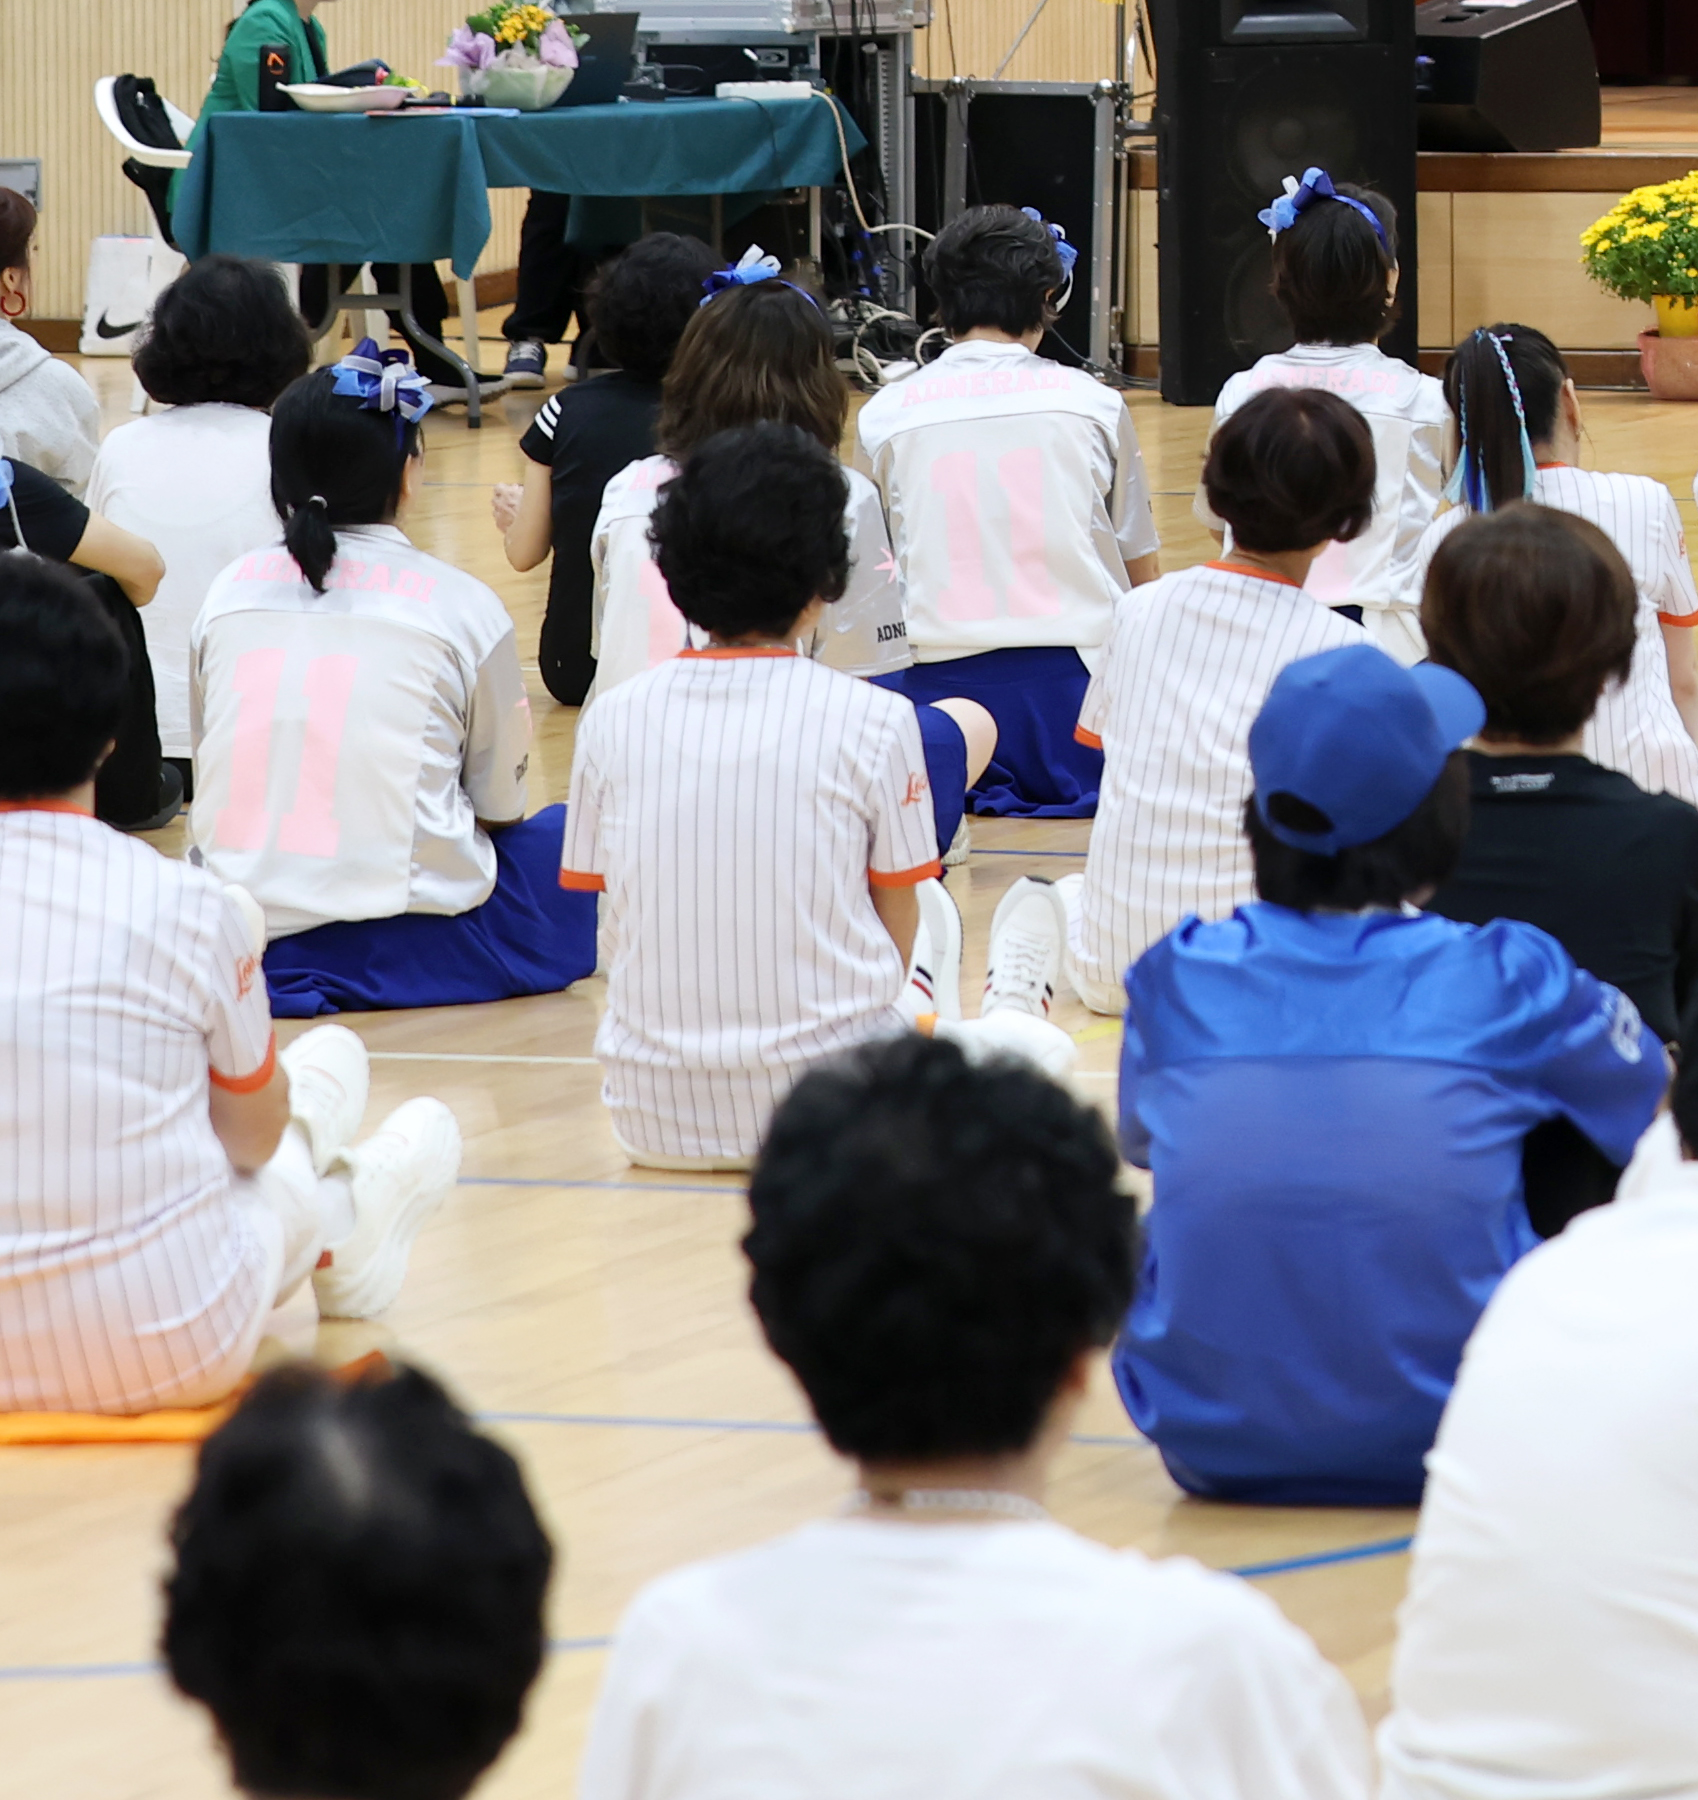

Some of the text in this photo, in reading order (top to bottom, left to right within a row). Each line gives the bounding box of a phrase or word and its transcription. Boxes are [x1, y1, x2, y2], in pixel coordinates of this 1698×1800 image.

[901, 367, 1072, 408] ADNERADI
[233, 554, 439, 603] ADNRADI
[929, 447, 1062, 621] 11
[214, 647, 360, 858] 11
